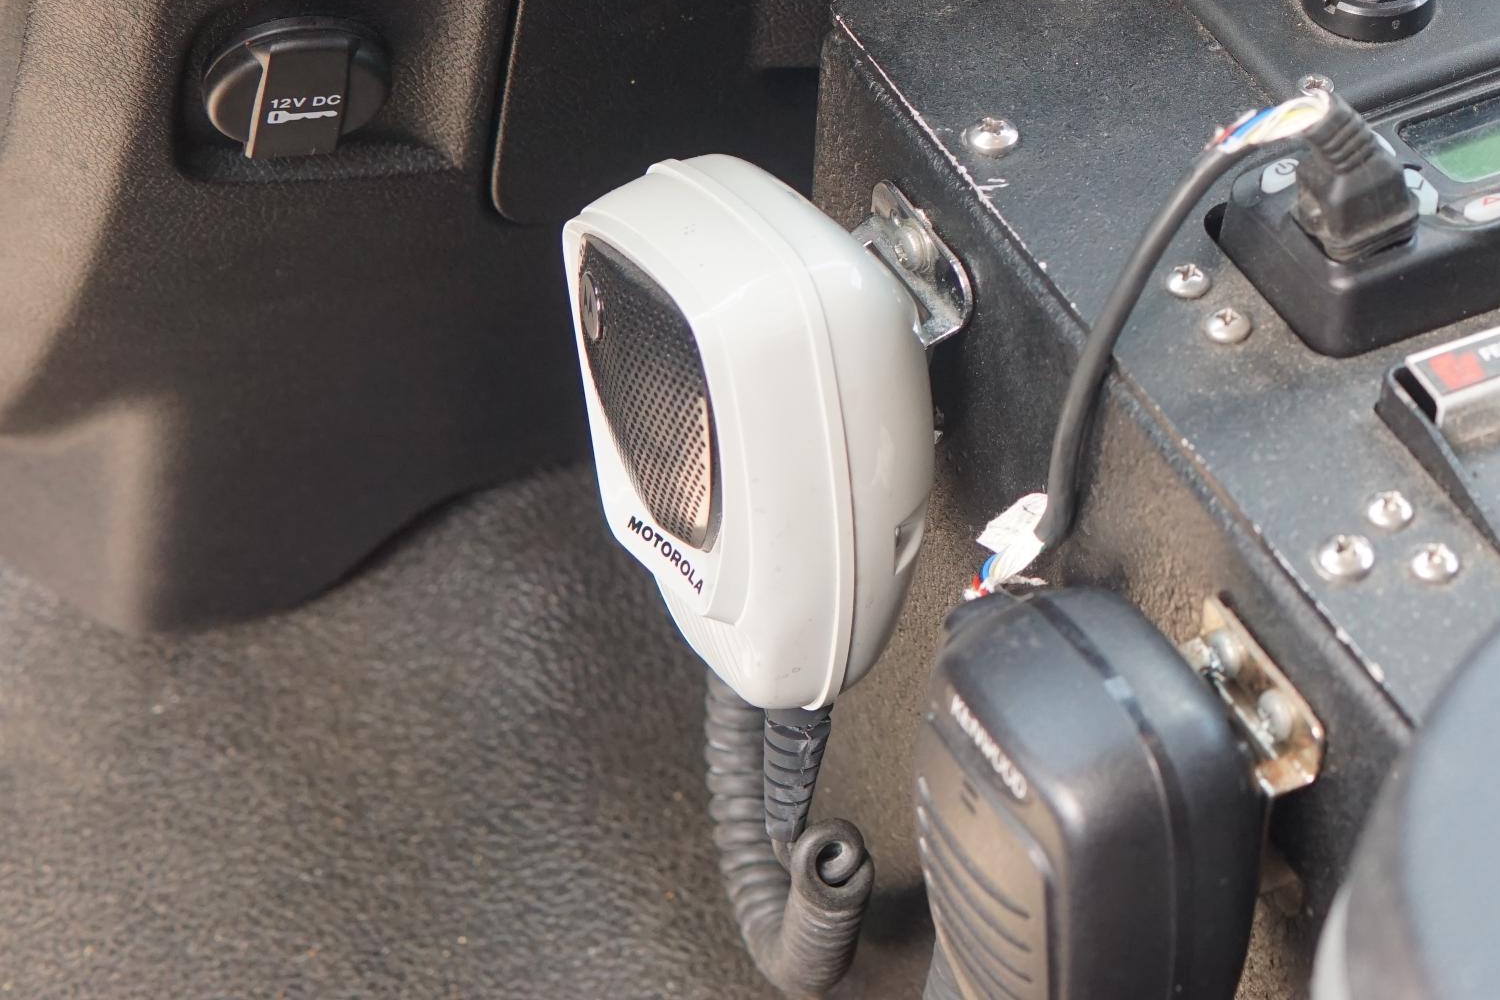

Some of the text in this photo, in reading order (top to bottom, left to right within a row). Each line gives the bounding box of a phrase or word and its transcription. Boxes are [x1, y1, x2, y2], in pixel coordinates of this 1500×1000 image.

[270, 94, 342, 109] 12V DC
[627, 514, 706, 597] MOTOROLA
